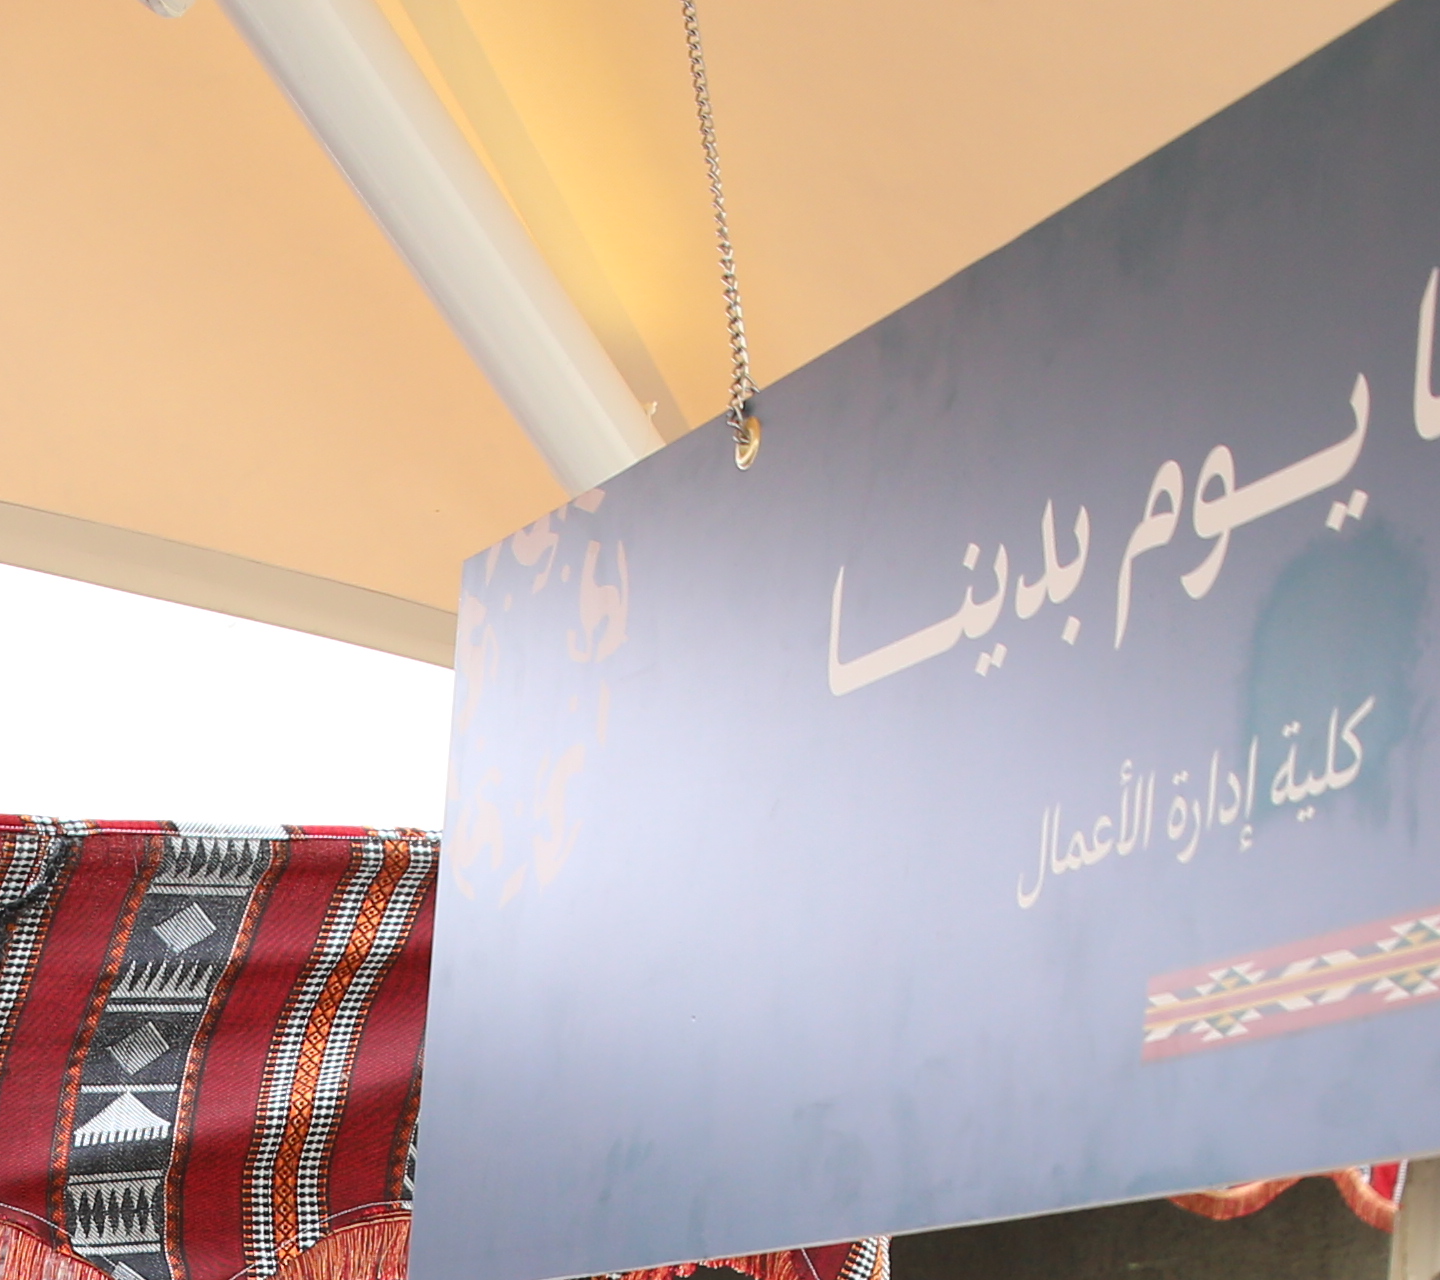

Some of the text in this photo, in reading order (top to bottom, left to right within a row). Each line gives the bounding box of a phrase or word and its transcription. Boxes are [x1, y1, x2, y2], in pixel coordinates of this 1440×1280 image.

[827, 498, 1091, 697] بدينا
[1114, 371, 1370, 650] يوم
[1016, 695, 1375, 910] كلية إدارة الأعمال
